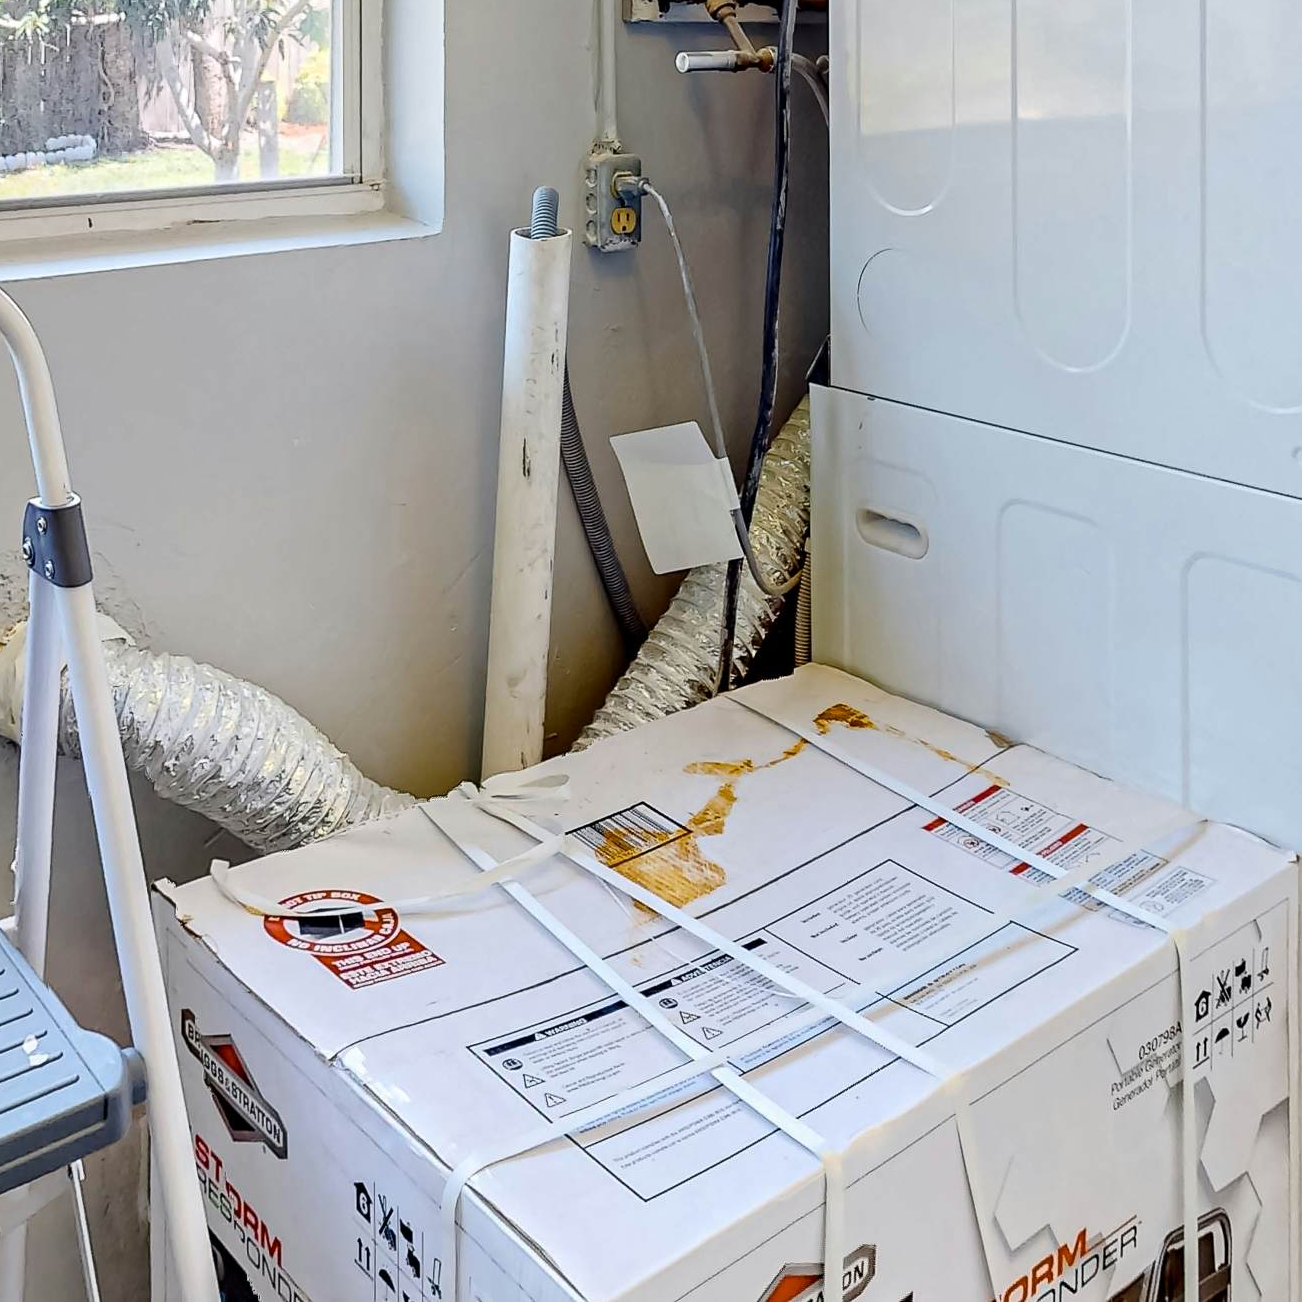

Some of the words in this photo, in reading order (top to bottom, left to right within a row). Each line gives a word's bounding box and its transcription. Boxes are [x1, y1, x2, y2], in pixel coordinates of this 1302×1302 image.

[330, 891, 362, 901] BOX
[286, 939, 311, 950] NO
[313, 934, 386, 953] INCLINAR
[363, 947, 392, 959] END
[391, 941, 412, 952] UP
[544, 1016, 587, 1039] WARNING
[230, 1081, 282, 1144] STRATTON
[195, 1134, 282, 1268] STORM
[993, 1227, 1087, 1302] ORM
